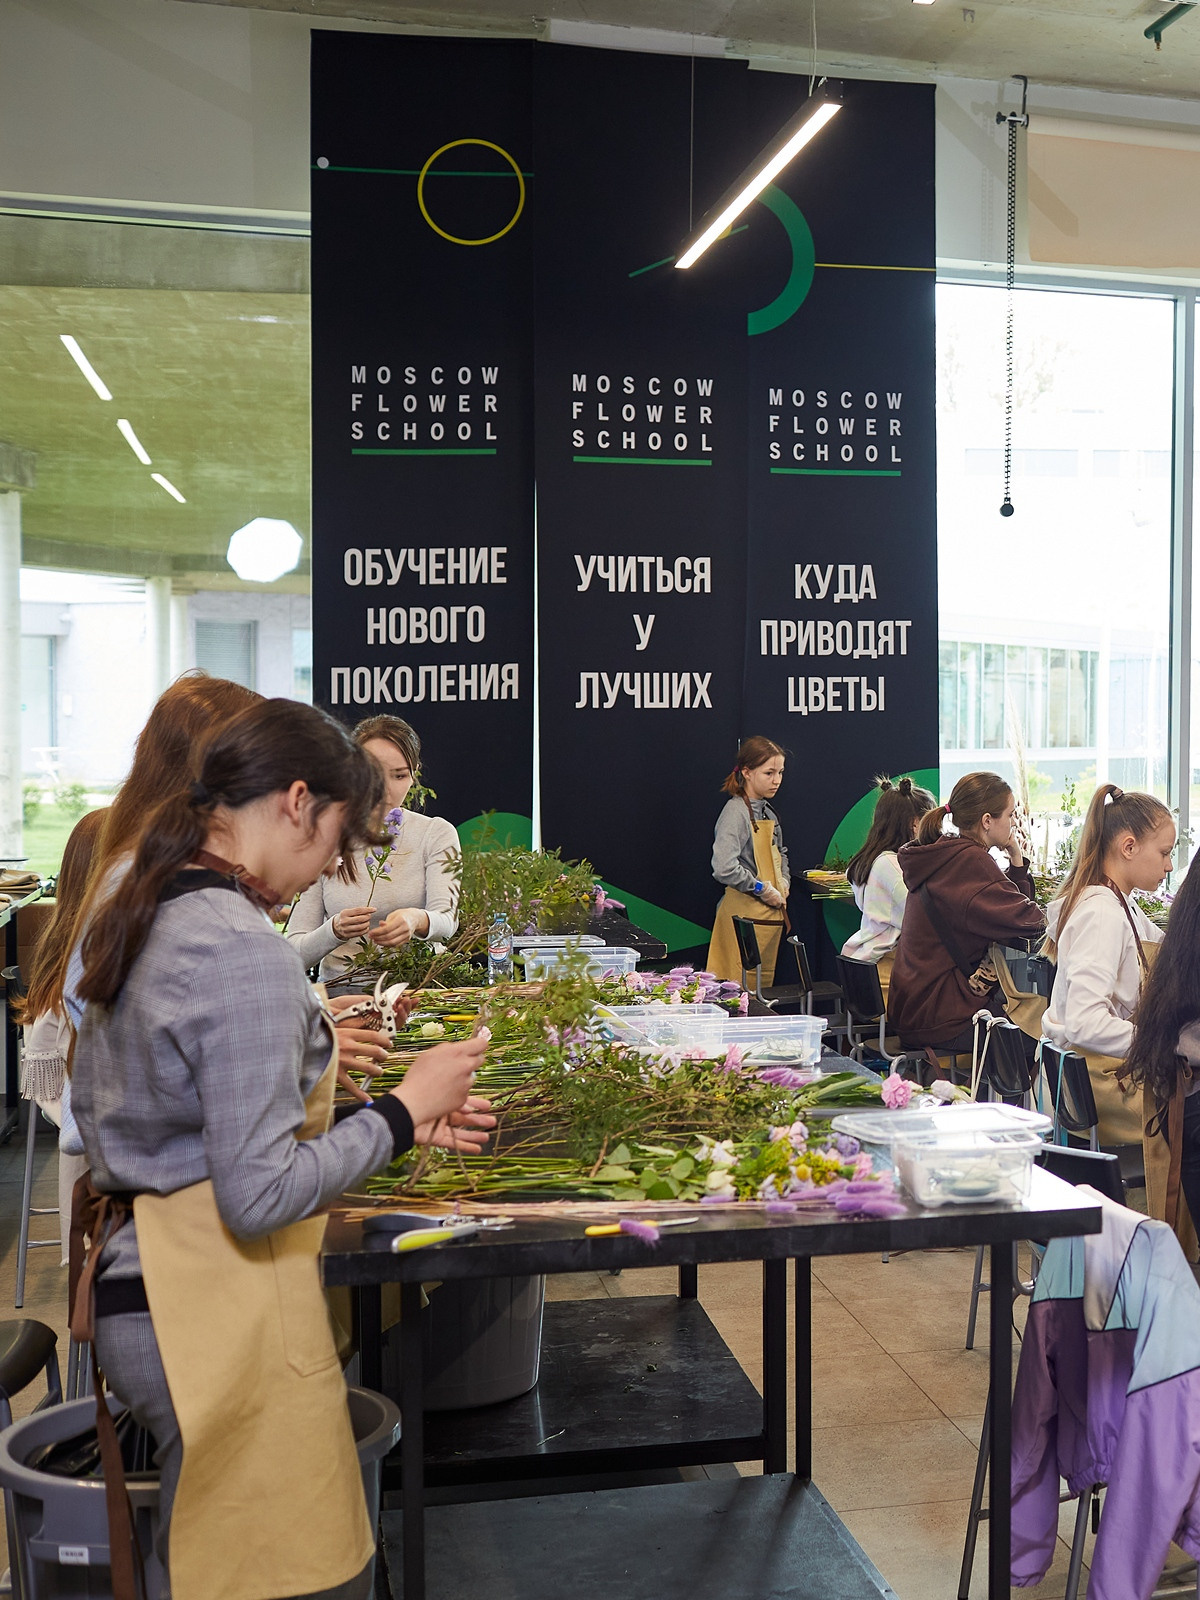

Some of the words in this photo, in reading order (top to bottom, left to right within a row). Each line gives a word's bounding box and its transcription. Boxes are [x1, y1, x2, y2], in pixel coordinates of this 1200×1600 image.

[351, 365, 499, 385] MOSCOW
[572, 373, 714, 397] MOSCOW
[351, 393, 498, 413] FLOWER
[572, 401, 713, 424] FLOWER
[769, 388, 902, 410] MOSCOW
[351, 421, 497, 441] SCHOOL
[769, 414, 902, 436] FLOWER
[572, 429, 713, 452] SCHOOL
[769, 441, 902, 463] SCHOOL
[344, 546, 508, 586] ОБУЧЕНИЕ
[573, 554, 712, 594] УЧИТЬСЯ
[794, 563, 877, 604] КУДА
[367, 605, 485, 645] НОВОГО
[632, 614, 656, 651] У
[760, 619, 912, 660] ПРИВОДЯТ
[330, 663, 519, 705] ПОКОЛЕНИЯ
[575, 671, 713, 709] ЛУЧШИХ
[787, 676, 885, 716] ЦВЕТЫ
